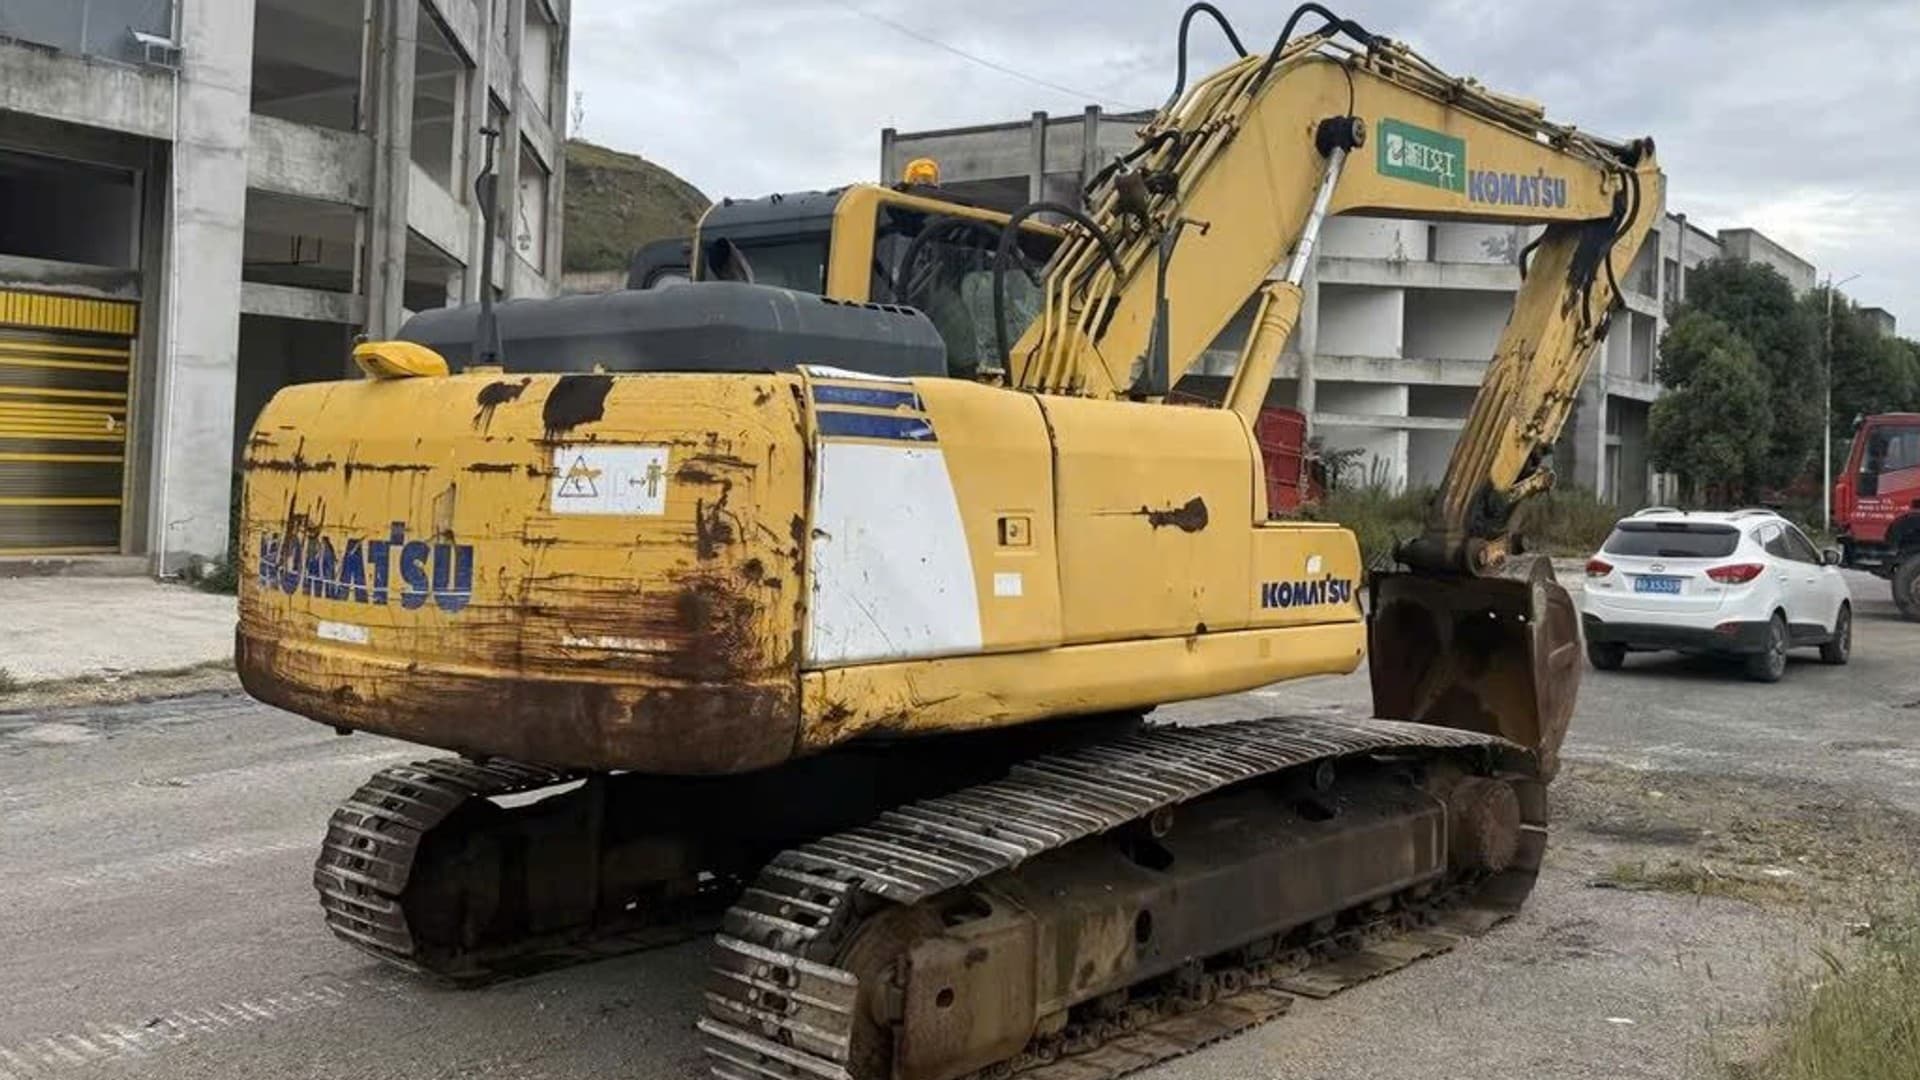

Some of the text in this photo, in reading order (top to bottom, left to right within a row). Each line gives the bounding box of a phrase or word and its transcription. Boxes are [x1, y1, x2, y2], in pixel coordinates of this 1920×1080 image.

[1469, 167, 1566, 208] KOMATSU
[259, 521, 474, 612] KOMATSU
[1261, 572, 1352, 609] KOMATSU
